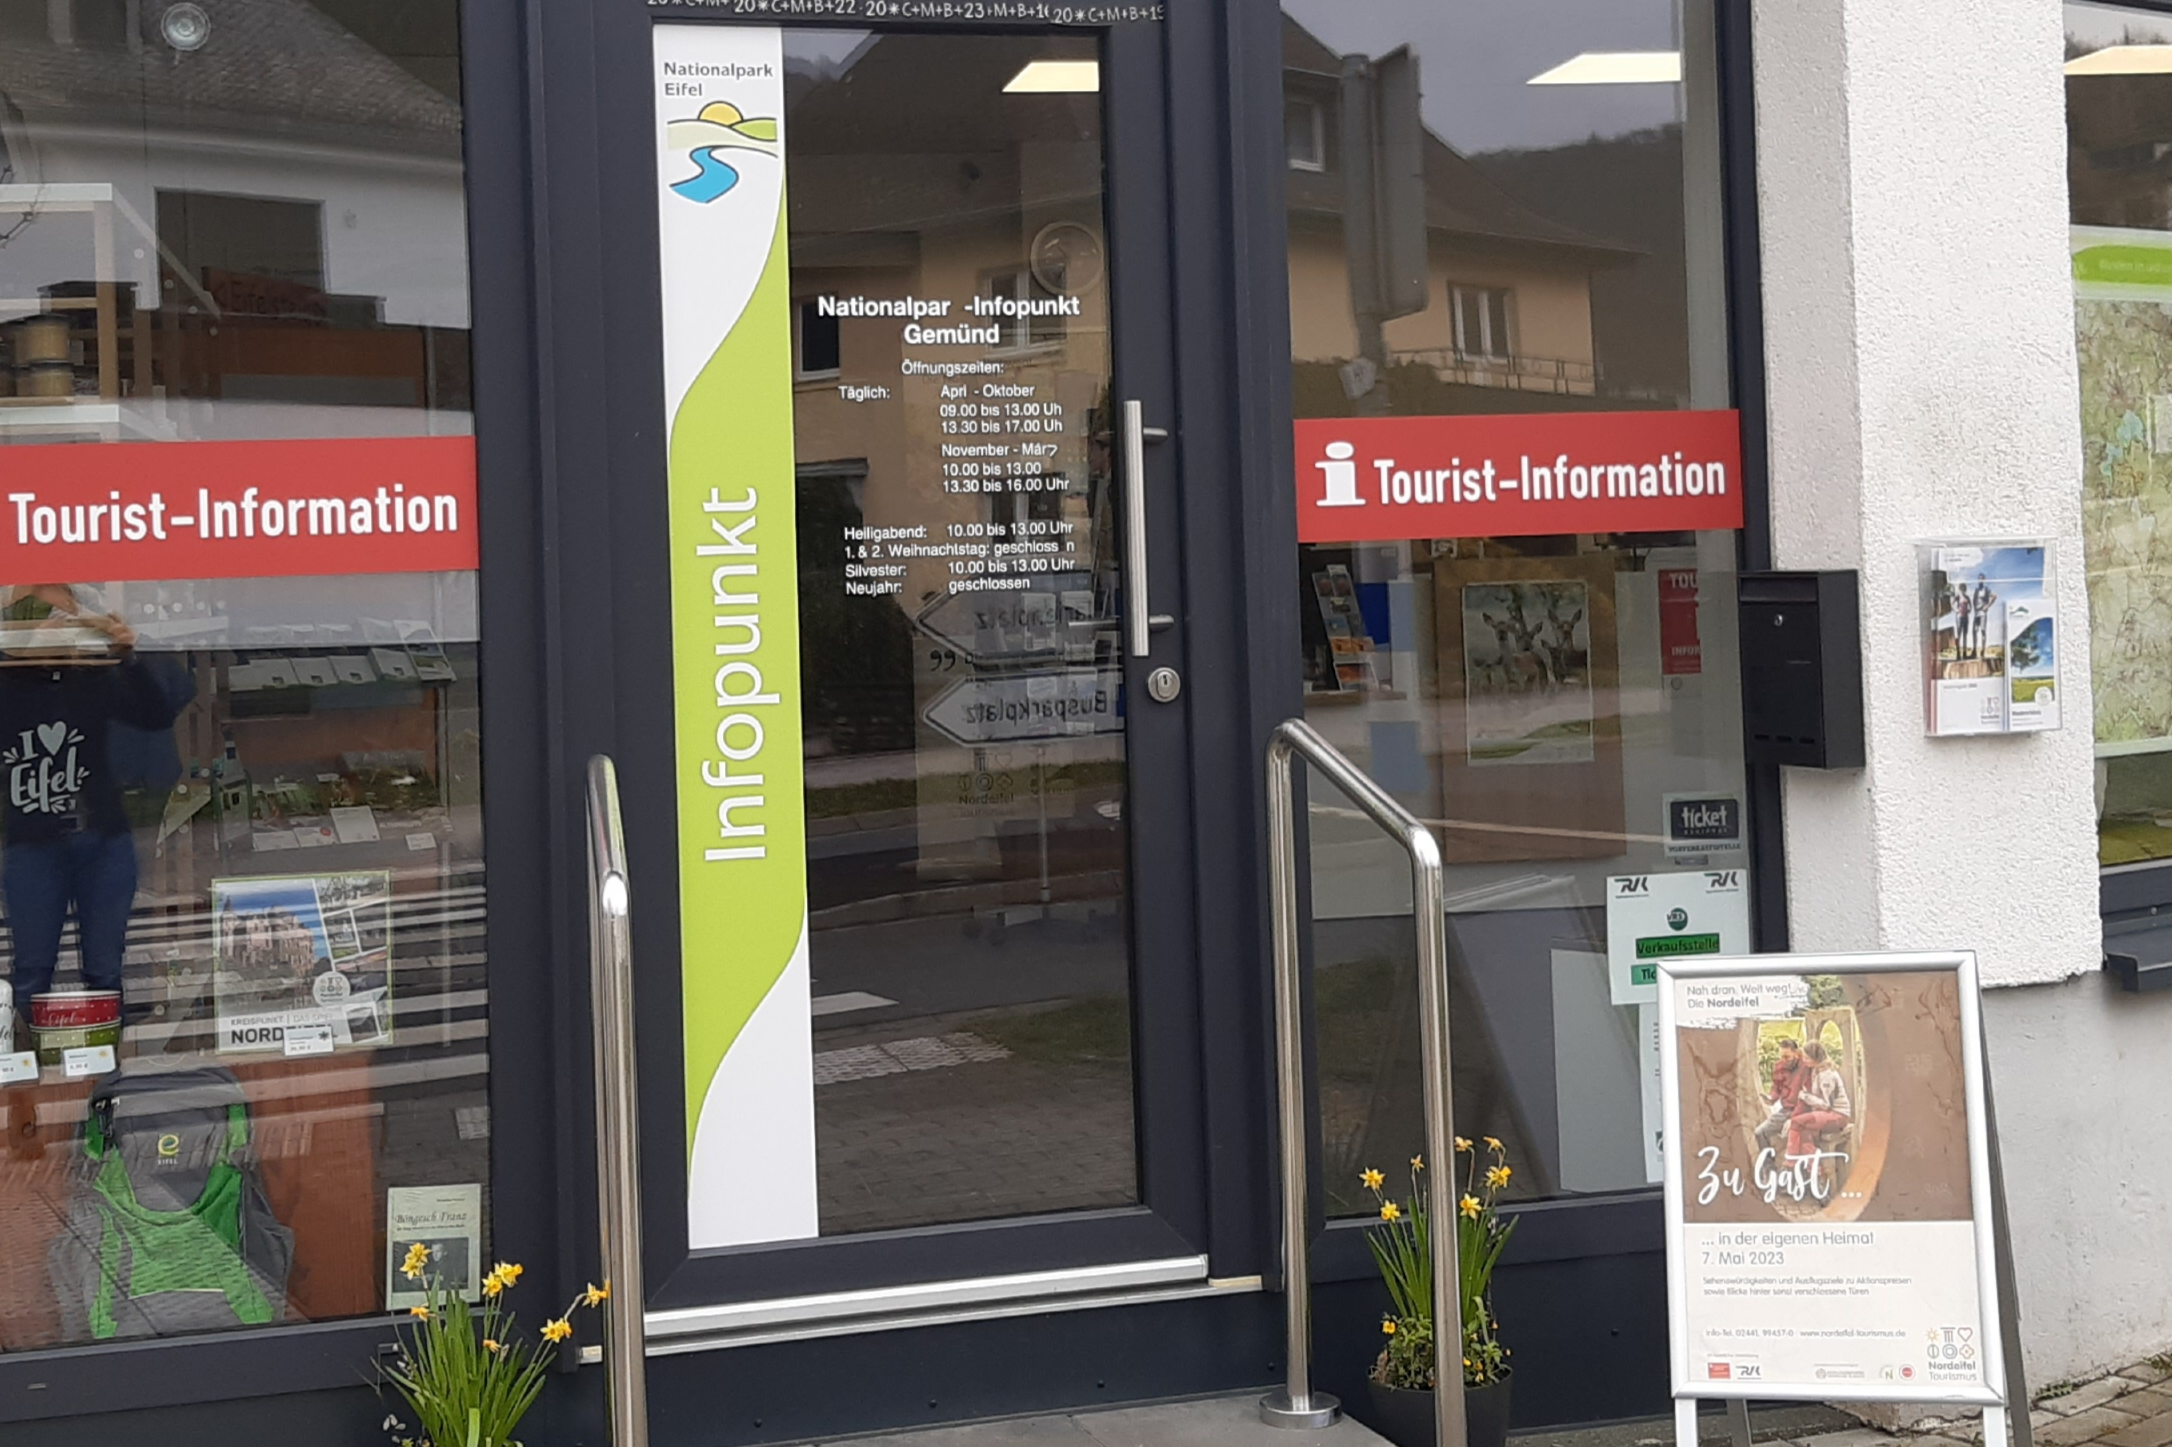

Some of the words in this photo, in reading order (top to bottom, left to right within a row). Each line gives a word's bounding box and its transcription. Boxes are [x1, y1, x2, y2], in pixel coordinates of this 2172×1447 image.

[664, 62, 774, 80] Nationalpark
[665, 83, 702, 96] Eifel
[904, 324, 1000, 345] Gemünd
[901, 359, 1004, 377] Öffnungszeiten:
[838, 385, 890, 402] Täglich:
[983, 384, 1035, 398] Oktober
[940, 404, 977, 417] 09.00
[980, 404, 1000, 416] bis
[1004, 403, 1040, 416] 13.00
[981, 420, 1000, 433] bis
[1005, 419, 1040, 432] 17.00
[942, 443, 1010, 457] November
[943, 463, 979, 476] 10.00
[983, 462, 1001, 475] bis
[1006, 462, 1041, 475] 13.00
[1374, 451, 1725, 505] Tourist-Information
[943, 480, 979, 492] 13.30
[983, 479, 1002, 492] bis
[1006, 479, 1042, 491] 16.00
[1046, 478, 1069, 490] Uhr
[8, 484, 457, 544] Tourist-Information
[844, 525, 927, 542] Heiligabend:
[947, 524, 983, 537] 10.00
[987, 523, 1006, 536] bis
[1010, 522, 1045, 535] 13.00
[1050, 521, 1073, 534] Uhr
[845, 546, 855, 559] 1.
[858, 545, 867, 558] &
[872, 545, 884, 558] 2.
[845, 564, 907, 578] Silvester:
[948, 561, 984, 574] 10.00
[988, 560, 1007, 573] bis
[1012, 559, 1047, 572] 13.00
[1051, 558, 1075, 571] Uhr
[846, 581, 902, 597] Neujahr:
[949, 577, 1030, 594] geschlossen
[696, 487, 781, 861] Infopunkt
[18, 730, 39, 760] I
[11, 746, 80, 813] Eifel
[1681, 804, 1727, 828] ticket
[1637, 938, 1719, 954] Verkaufsstelle
[1687, 985, 1708, 995] Nah
[1740, 983, 1763, 994] Weit
[1688, 998, 1704, 1008] Die
[1707, 996, 1759, 1008] Nordeifel
[1698, 1146, 1745, 1205] Zu
[1754, 1147, 1849, 1203] Gast
[1718, 1231, 1731, 1245] in
[1735, 1231, 1758, 1245] der
[1762, 1231, 1819, 1248] eigenen
[1823, 1230, 1874, 1245] Heimat
[1702, 1252, 1714, 1264] 7.
[1718, 1252, 1745, 1264] Mai
[1750, 1251, 1784, 1265] 2023
[1779, 1277, 1793, 1285] und
[1929, 1360, 1976, 1371] Nordeifel
[1929, 1371, 1977, 1381] Tourismus
